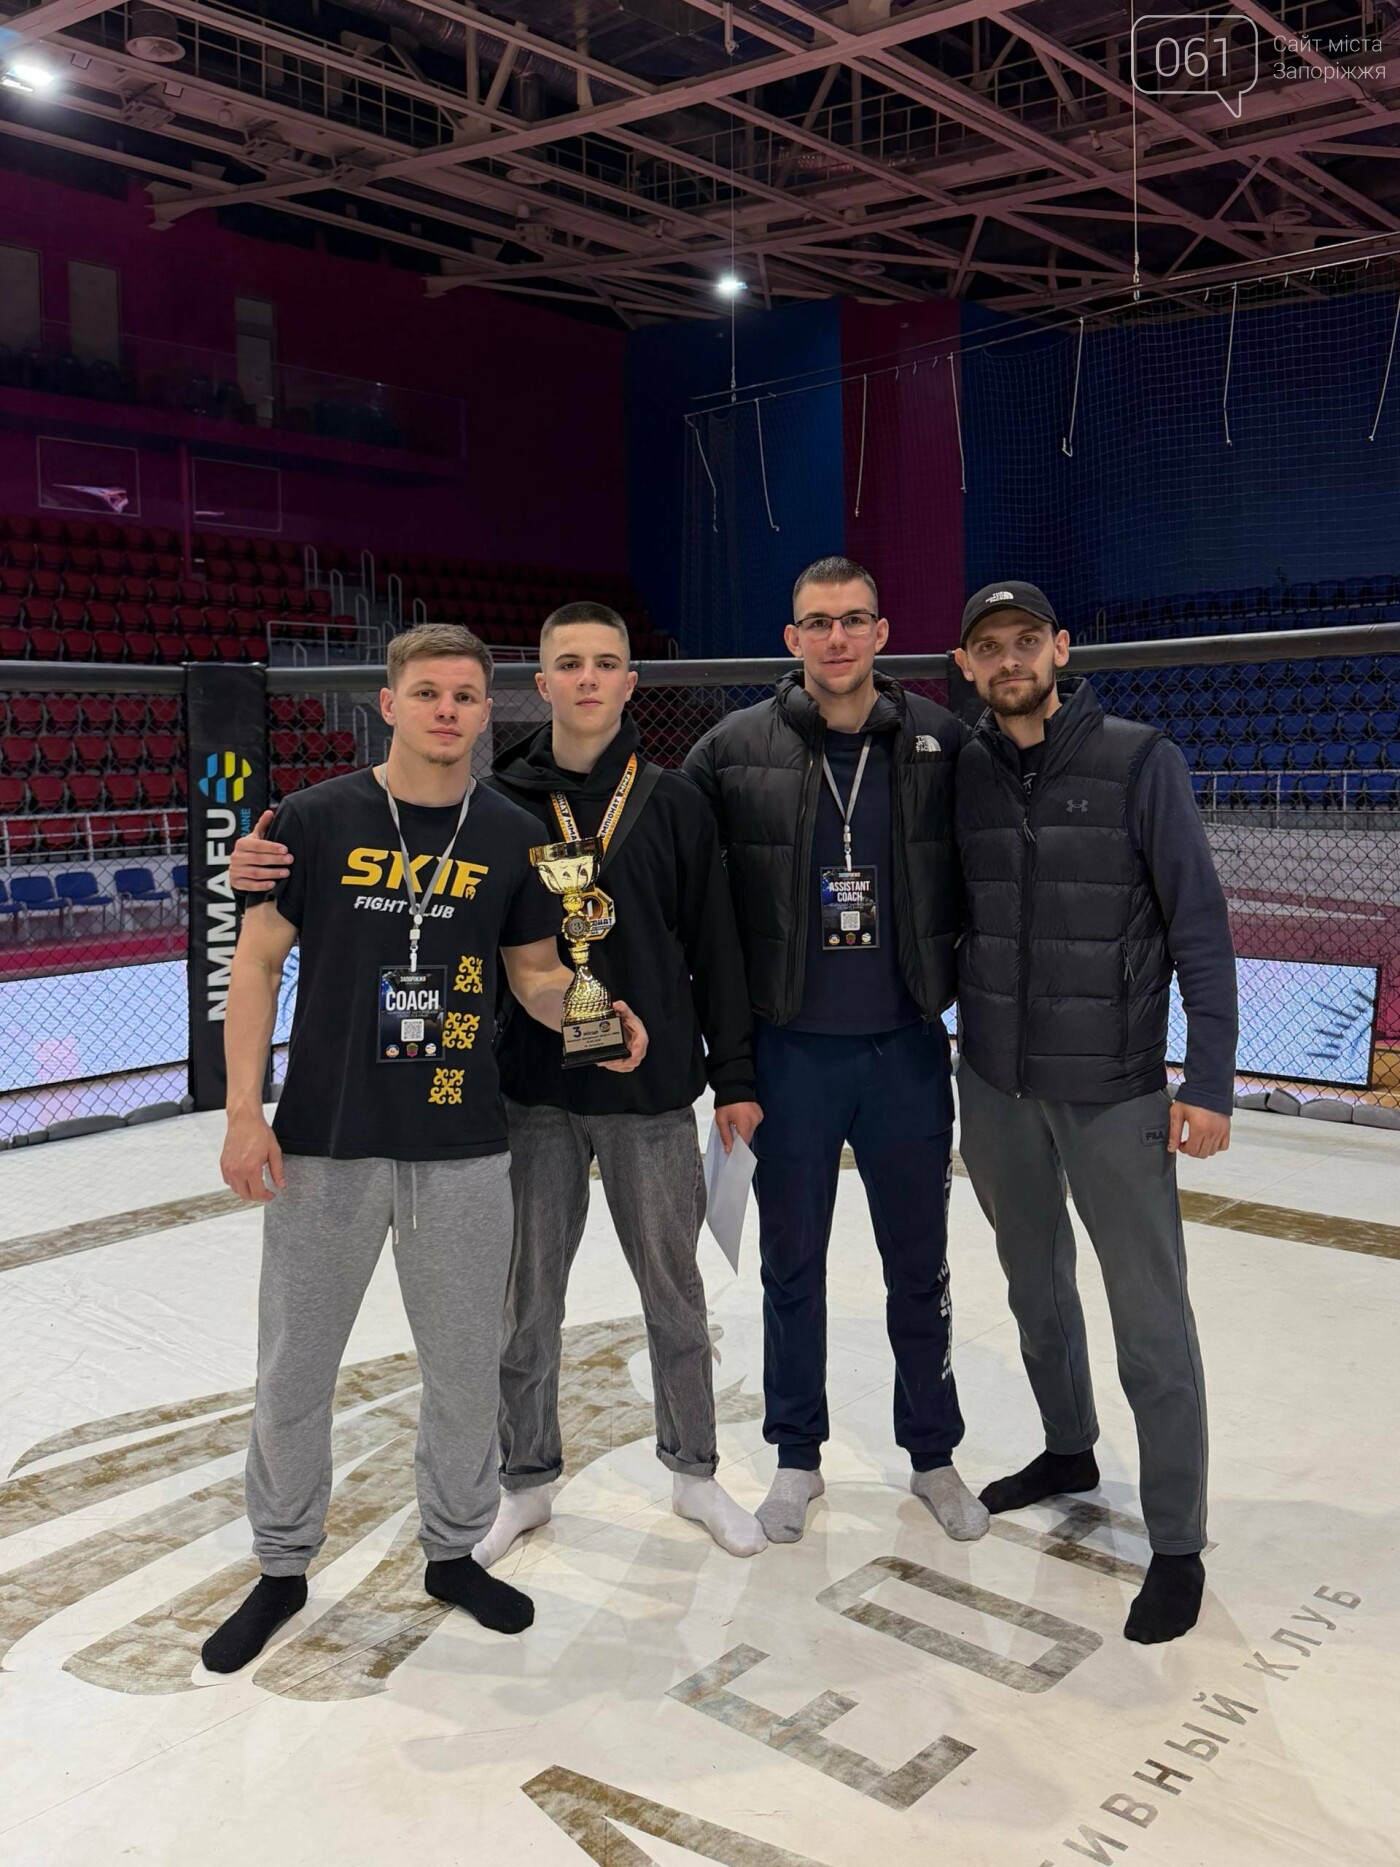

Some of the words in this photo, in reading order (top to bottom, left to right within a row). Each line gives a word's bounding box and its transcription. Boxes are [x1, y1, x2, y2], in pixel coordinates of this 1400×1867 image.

[341, 847, 490, 899] SKIF
[829, 880, 871, 892] ASSISTANT
[354, 895, 408, 914] FIGHT
[837, 891, 863, 902] COACH
[385, 989, 440, 1012] COACH
[573, 1026, 582, 1038] 3
[1039, 1690, 1259, 1867] ИВНЫЙ
[1242, 1584, 1362, 1682] КЛУБ
